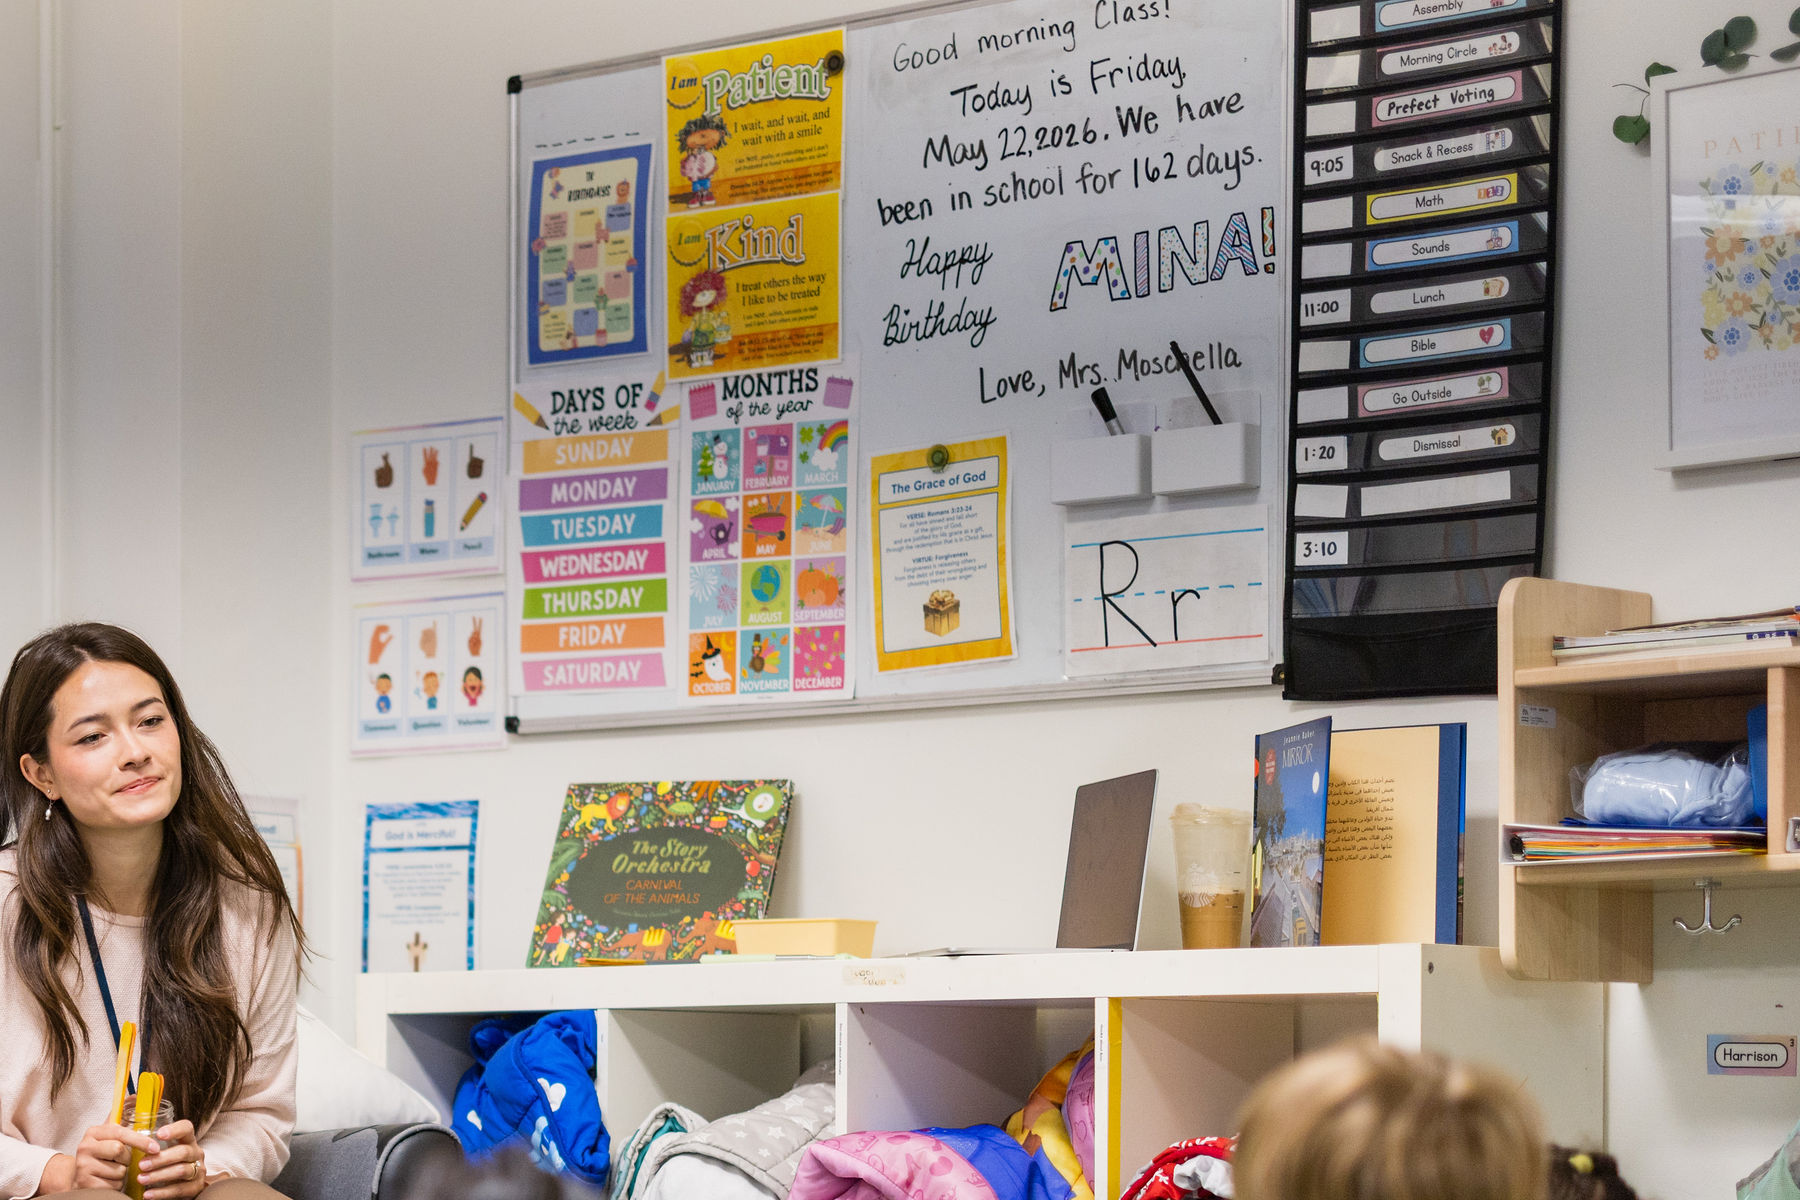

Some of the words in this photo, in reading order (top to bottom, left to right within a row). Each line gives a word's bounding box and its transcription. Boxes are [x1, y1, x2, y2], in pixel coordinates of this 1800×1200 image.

[1413, 0, 1463, 17] Assembly
[894, 33, 959, 73] Good
[978, 19, 1076, 53] morning
[1095, 0, 1171, 30] Class!
[1400, 51, 1443, 68] Morning
[1447, 44, 1477, 60] Circle
[671, 77, 677, 90] I
[678, 76, 698, 88] am
[702, 54, 832, 116] Patient
[950, 82, 1033, 117] Today
[1050, 69, 1073, 98] is
[1387, 94, 1440, 117] Prefect
[1450, 85, 1495, 106] Voting
[767, 115, 785, 129] and
[812, 107, 831, 121] and
[742, 134, 763, 147] wait
[765, 129, 787, 143] with
[788, 131, 794, 140] a
[797, 125, 822, 138] smile
[923, 134, 988, 171] May
[1116, 105, 1159, 138] We
[1176, 91, 1245, 124] have
[1310, 156, 1344, 177] 9:05
[1391, 149, 1423, 165] Snack
[1426, 147, 1433, 158] &
[1436, 142, 1473, 157] Recess
[878, 197, 933, 226] been
[950, 183, 973, 212] in
[983, 171, 1064, 207] school
[1076, 162, 1121, 196] for
[1133, 152, 1178, 189] 162
[1187, 144, 1262, 191] days.
[1415, 194, 1444, 209] Math
[704, 213, 806, 273] Kind
[1411, 242, 1450, 256] Sounds
[900, 236, 994, 291] Happy
[1050, 206, 1275, 312] MINA!
[742, 278, 762, 292] treat
[764, 275, 791, 289] others
[792, 274, 806, 285] the
[808, 273, 827, 285] way
[748, 292, 765, 306] like
[767, 293, 777, 303] to
[778, 290, 789, 302] be
[790, 286, 821, 300] treated
[1304, 301, 1339, 318] 11:00
[1413, 290, 1445, 304] Lunch
[883, 296, 997, 348] Birthday
[1411, 339, 1436, 353] Bible
[722, 368, 820, 401] MONTHS
[979, 366, 1046, 405] Love,
[1393, 393, 1408, 405] Go
[1412, 386, 1452, 402] Outside
[551, 387, 606, 416] DAYS
[616, 383, 644, 409] OF
[554, 416, 581, 437] the
[589, 411, 639, 435] week
[726, 402, 744, 425] of
[749, 402, 771, 417] the
[776, 399, 814, 421] year
[555, 437, 634, 466] SUNDAY
[1304, 446, 1335, 462] 1:20
[1413, 435, 1461, 452] Dismissal
[695, 480, 736, 494] JANUARY
[745, 475, 790, 489] FEBRUARY
[804, 470, 840, 485] MARCH
[892, 483, 911, 495] The
[913, 479, 946, 492] Grace
[948, 474, 960, 486] of
[962, 470, 987, 484] God
[551, 476, 638, 504] MONDAY
[551, 512, 637, 539] TUESDAY
[702, 548, 727, 560] APRIL
[755, 543, 777, 556] MAY
[808, 538, 834, 553] JUNE
[1303, 541, 1337, 558] 3:10
[540, 548, 649, 579] WEDNESDAY
[541, 586, 644, 615] THURSDAY
[702, 615, 723, 629] JULY
[748, 611, 783, 624] AUGUST
[794, 608, 845, 622] SEPTEMBER
[558, 623, 627, 648] FRIDAY
[542, 660, 641, 687] SATURDAY
[795, 676, 844, 690] DECEMBER
[693, 681, 732, 695] OCTOBER
[740, 679, 790, 693] NOVEMBER
[1282, 743, 1313, 769] MIRROR
[632, 840, 658, 855] The
[660, 838, 708, 861] Story
[612, 853, 711, 875] Orchestra
[625, 878, 683, 892] CARNIVAL
[603, 893, 622, 906] OF
[625, 892, 646, 905] THE
[648, 892, 700, 905] ANIMALS
[1723, 1047, 1778, 1062] Harrison
